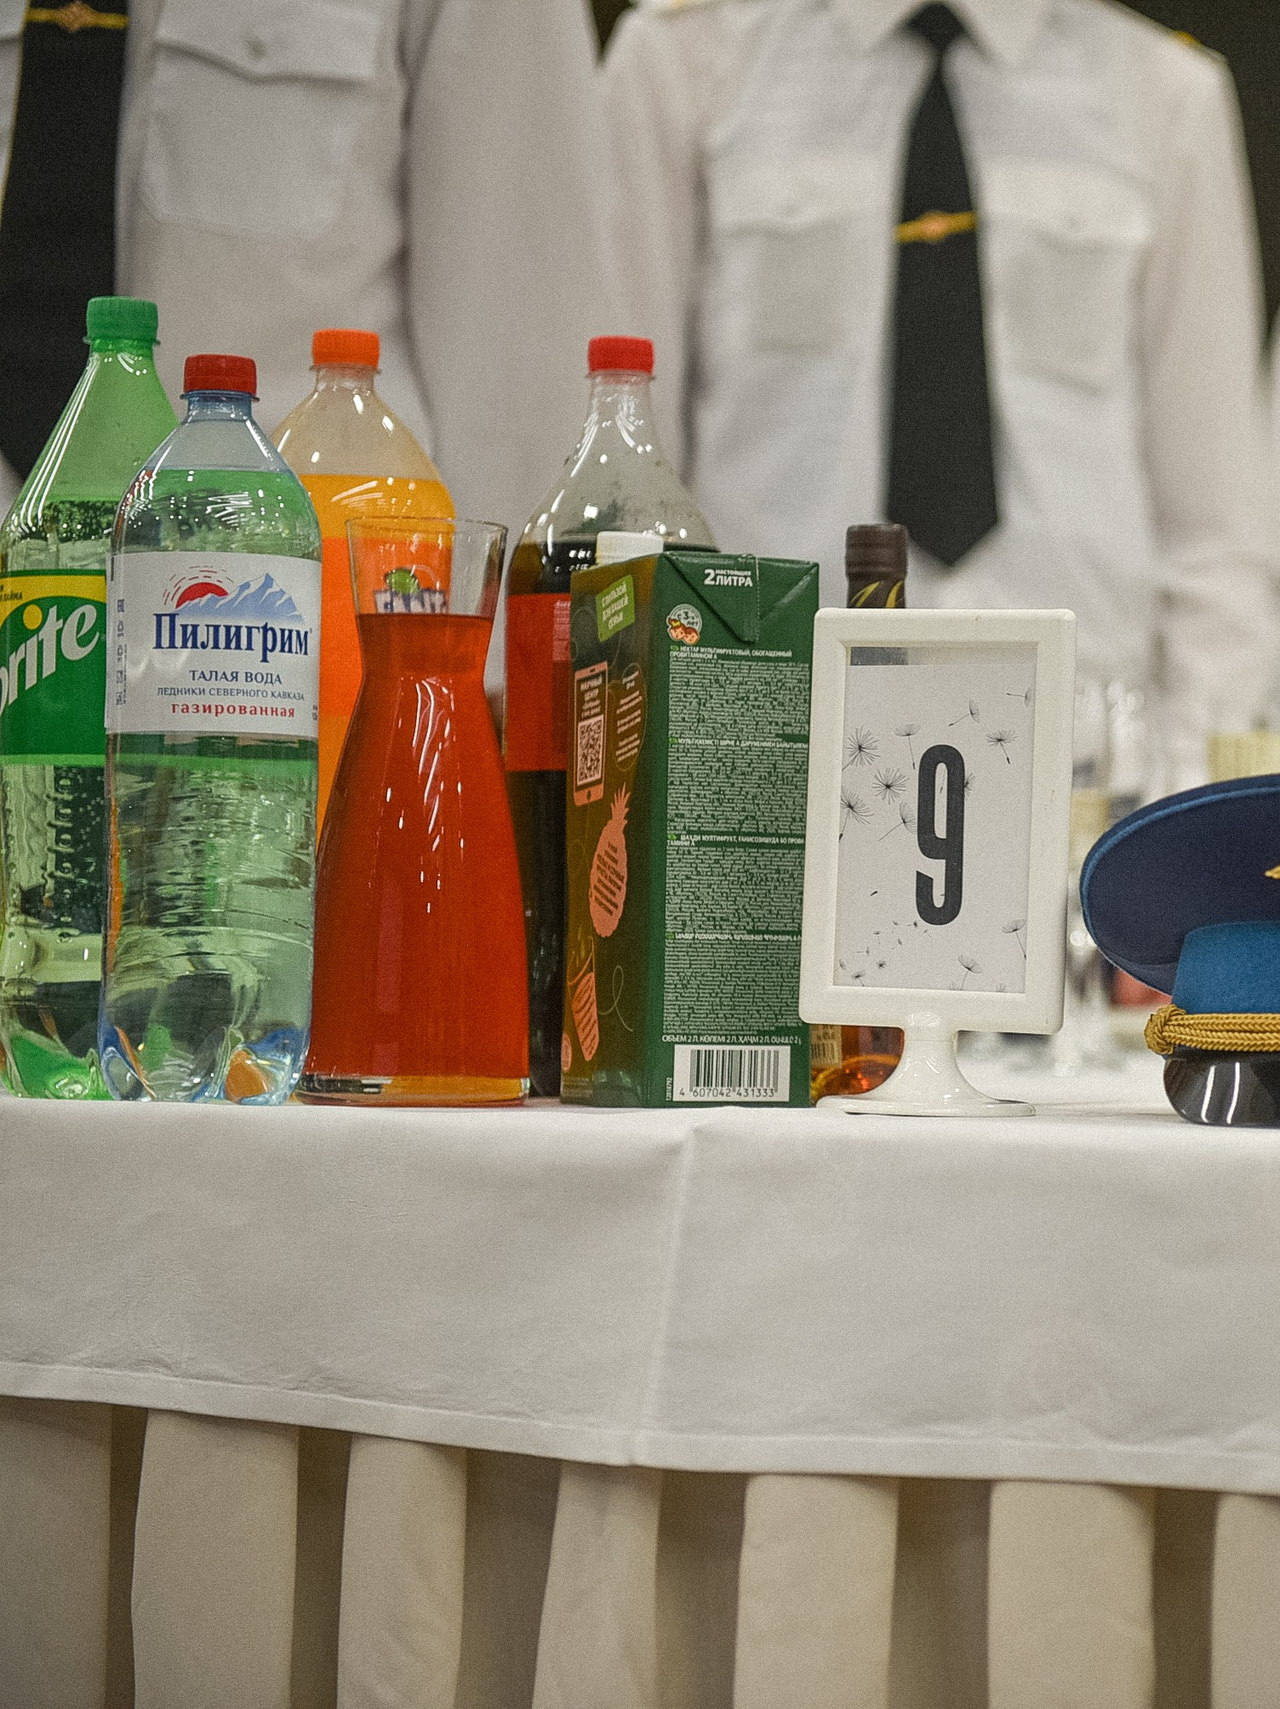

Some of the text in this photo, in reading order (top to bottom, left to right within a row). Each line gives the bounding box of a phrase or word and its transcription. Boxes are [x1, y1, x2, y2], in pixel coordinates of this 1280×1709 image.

[704, 568, 753, 587] 2 ЛИТРА
[153, 612, 309, 663] Пилигрим
[189, 670, 282, 685] ТАЛАЯ ВОДА
[156, 687, 305, 701] ЛЕДНИКИ СЕВЕРНОГО КАВКАЗА
[171, 702, 295, 718] газированная
[915, 743, 965, 925] 9
[679, 1087, 775, 1098] 4 607042 431333
